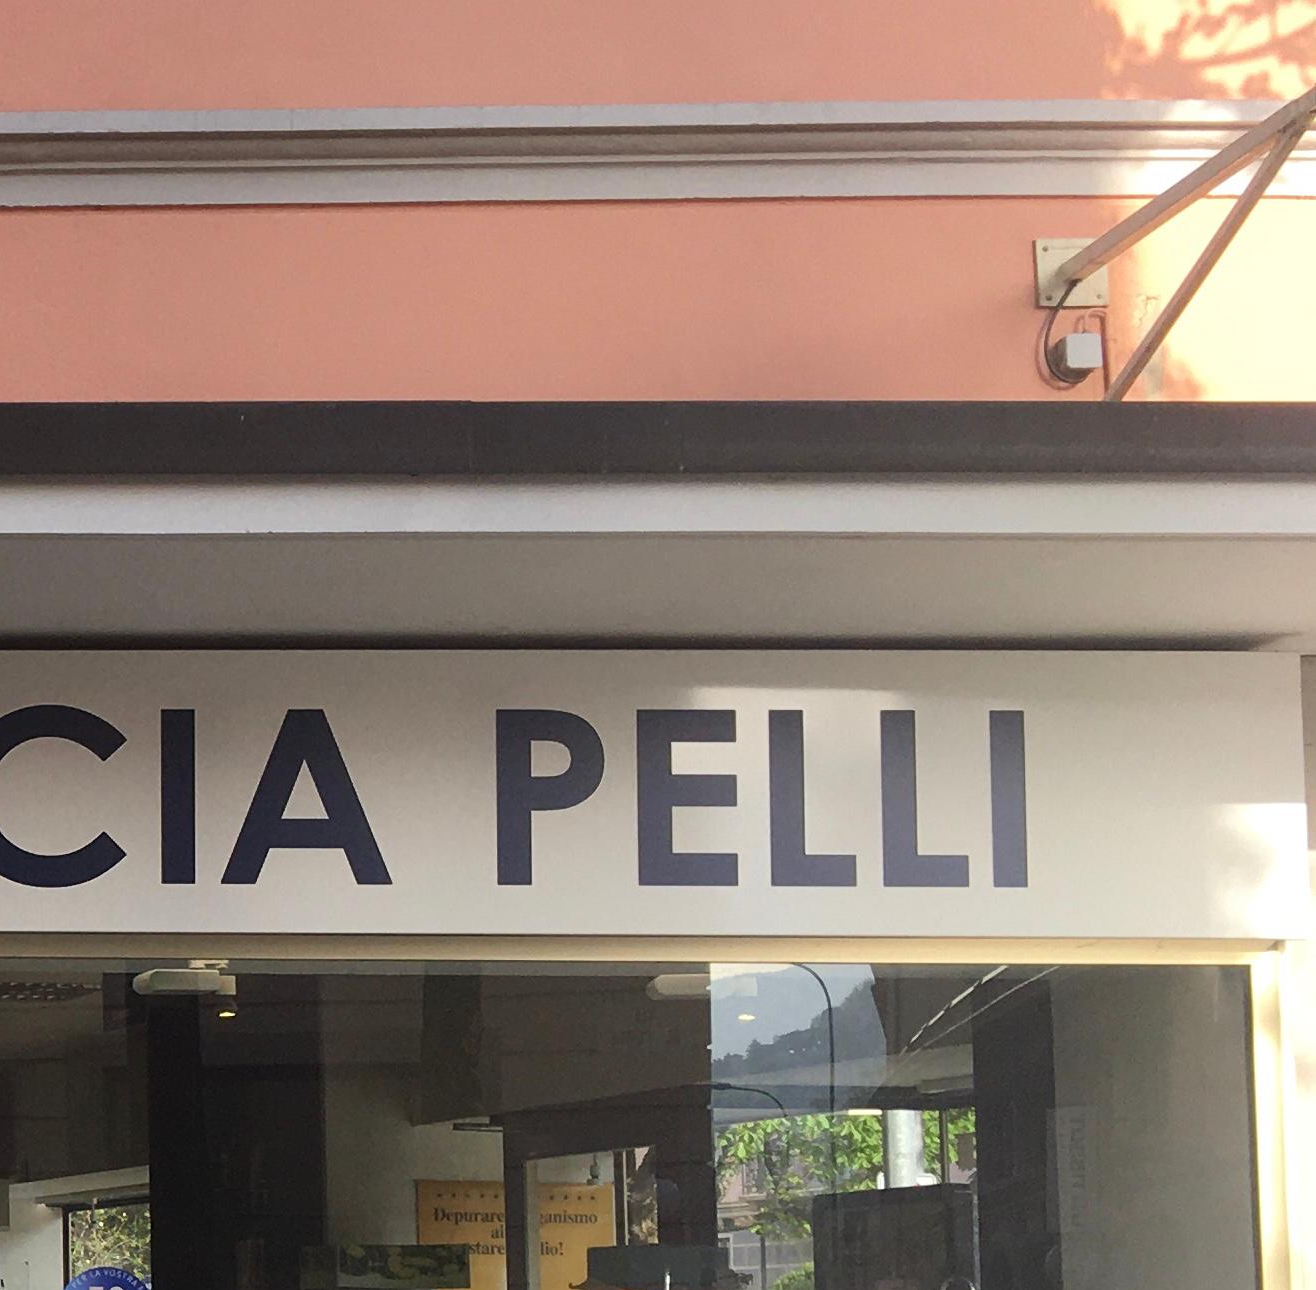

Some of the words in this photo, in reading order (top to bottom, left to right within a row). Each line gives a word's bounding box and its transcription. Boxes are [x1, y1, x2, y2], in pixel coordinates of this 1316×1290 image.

[494, 708, 1029, 888] PELLI
[432, 1208, 505, 1224] Depurare
[540, 1242, 564, 1256] lio!
